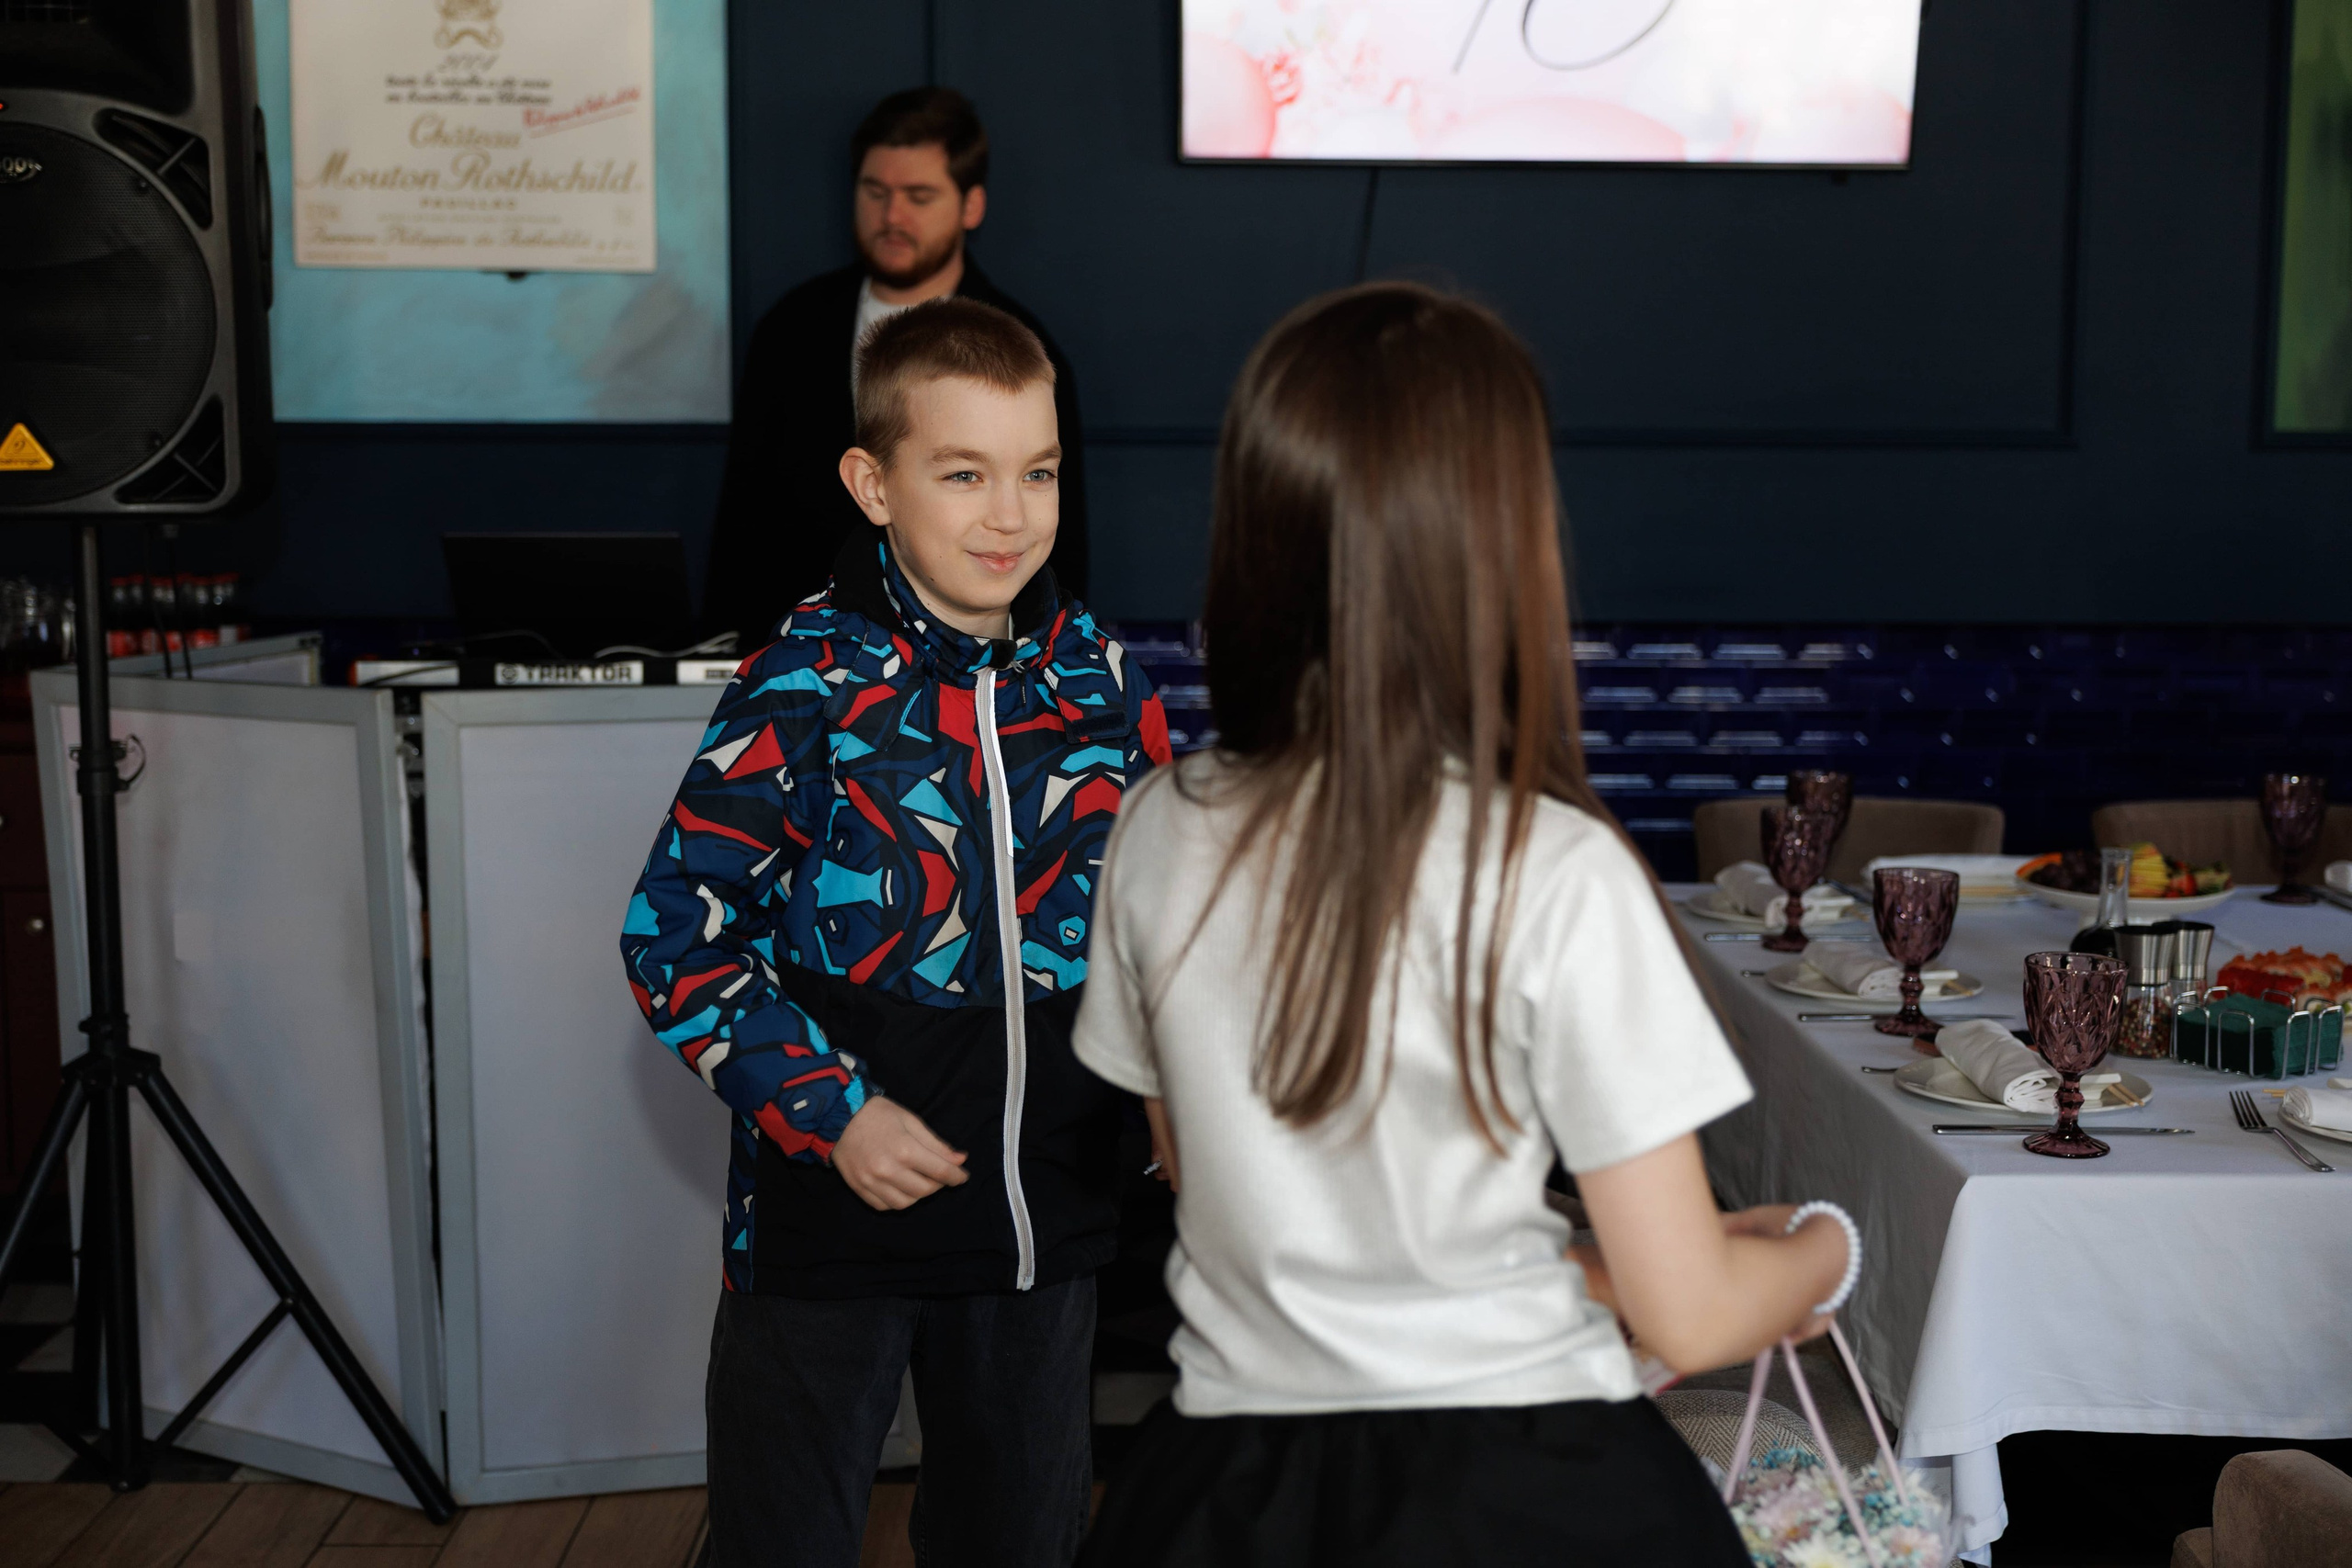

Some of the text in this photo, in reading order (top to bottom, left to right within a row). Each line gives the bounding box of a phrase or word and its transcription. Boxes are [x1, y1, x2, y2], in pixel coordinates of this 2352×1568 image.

[305, 150, 639, 194] Mouton Rothschild
[525, 664, 632, 683] TRAKTOR
